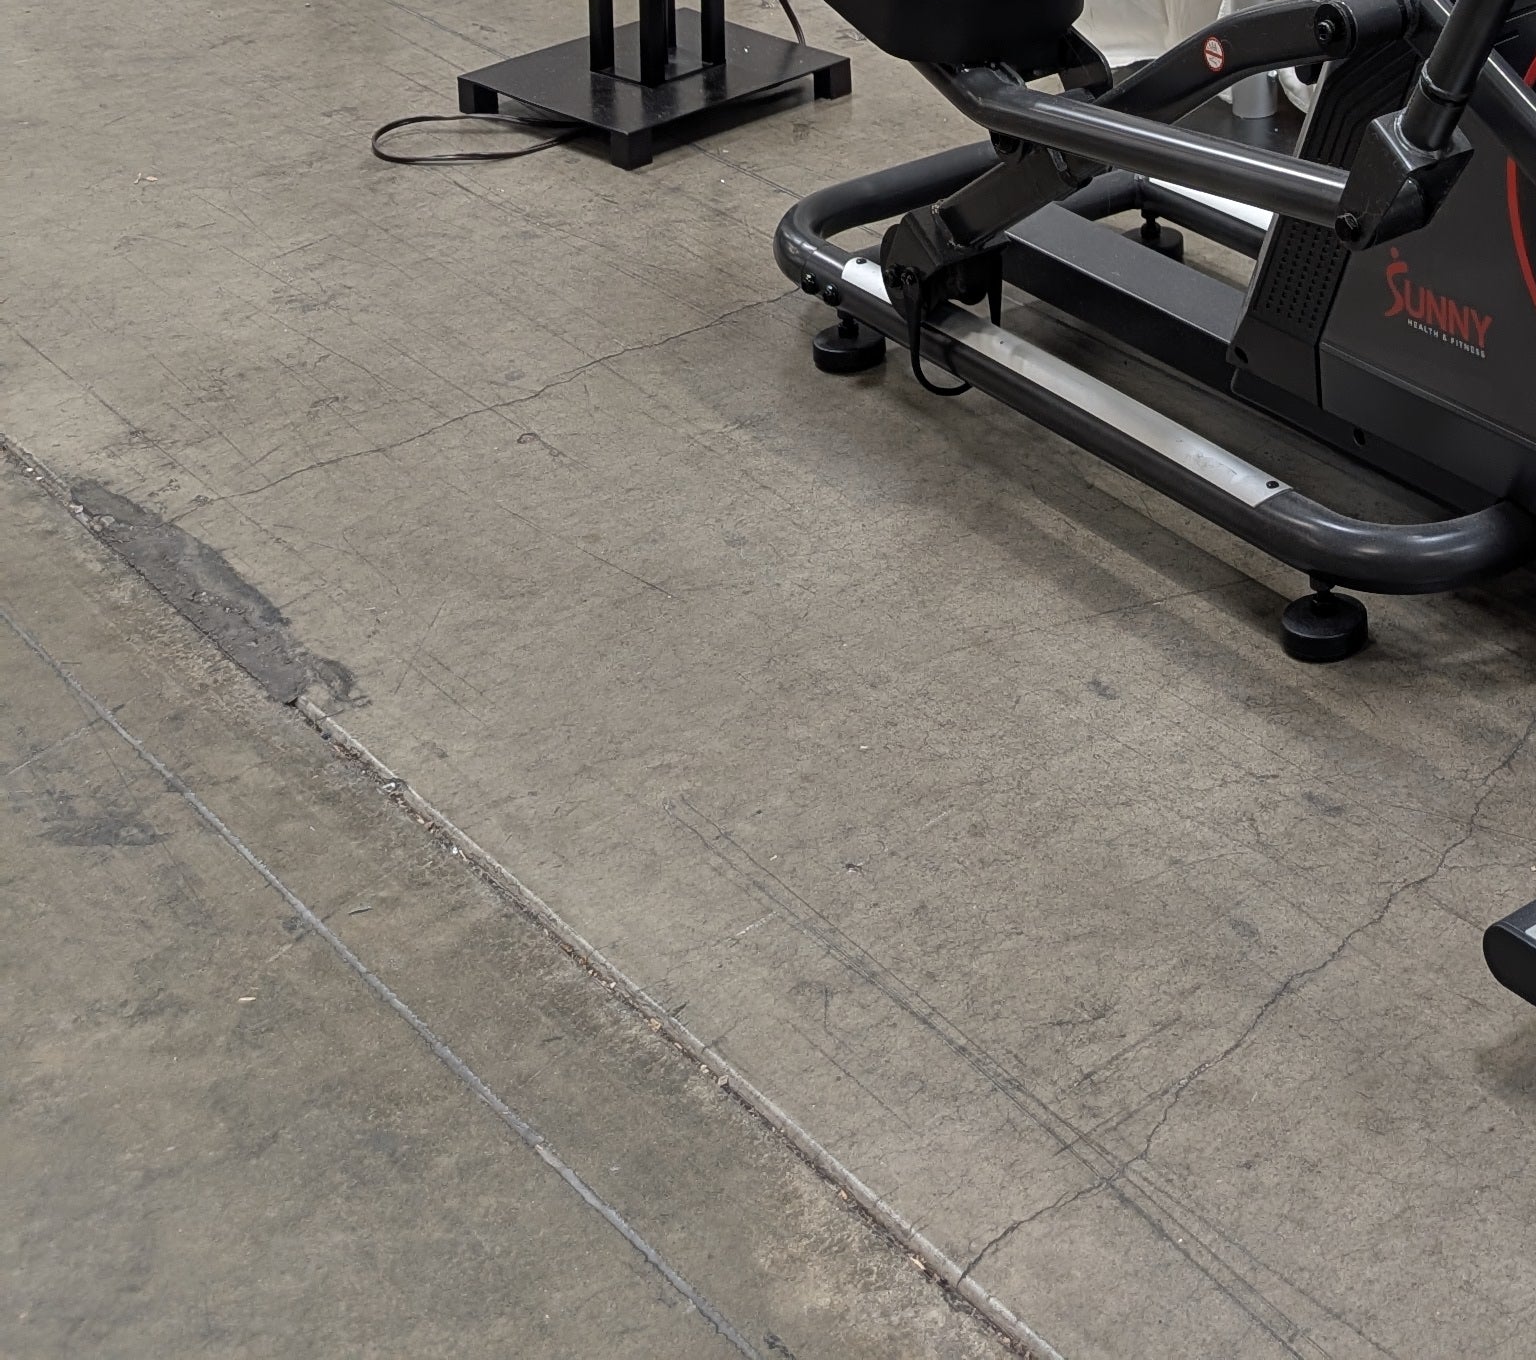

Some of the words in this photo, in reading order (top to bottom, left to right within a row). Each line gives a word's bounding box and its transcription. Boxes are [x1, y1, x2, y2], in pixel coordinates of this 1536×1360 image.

[1384, 247, 1493, 348] SUNNY
[1407, 318, 1439, 339] HEALTH
[1442, 333, 1448, 342] &
[1450, 337, 1486, 359] FITNESS
